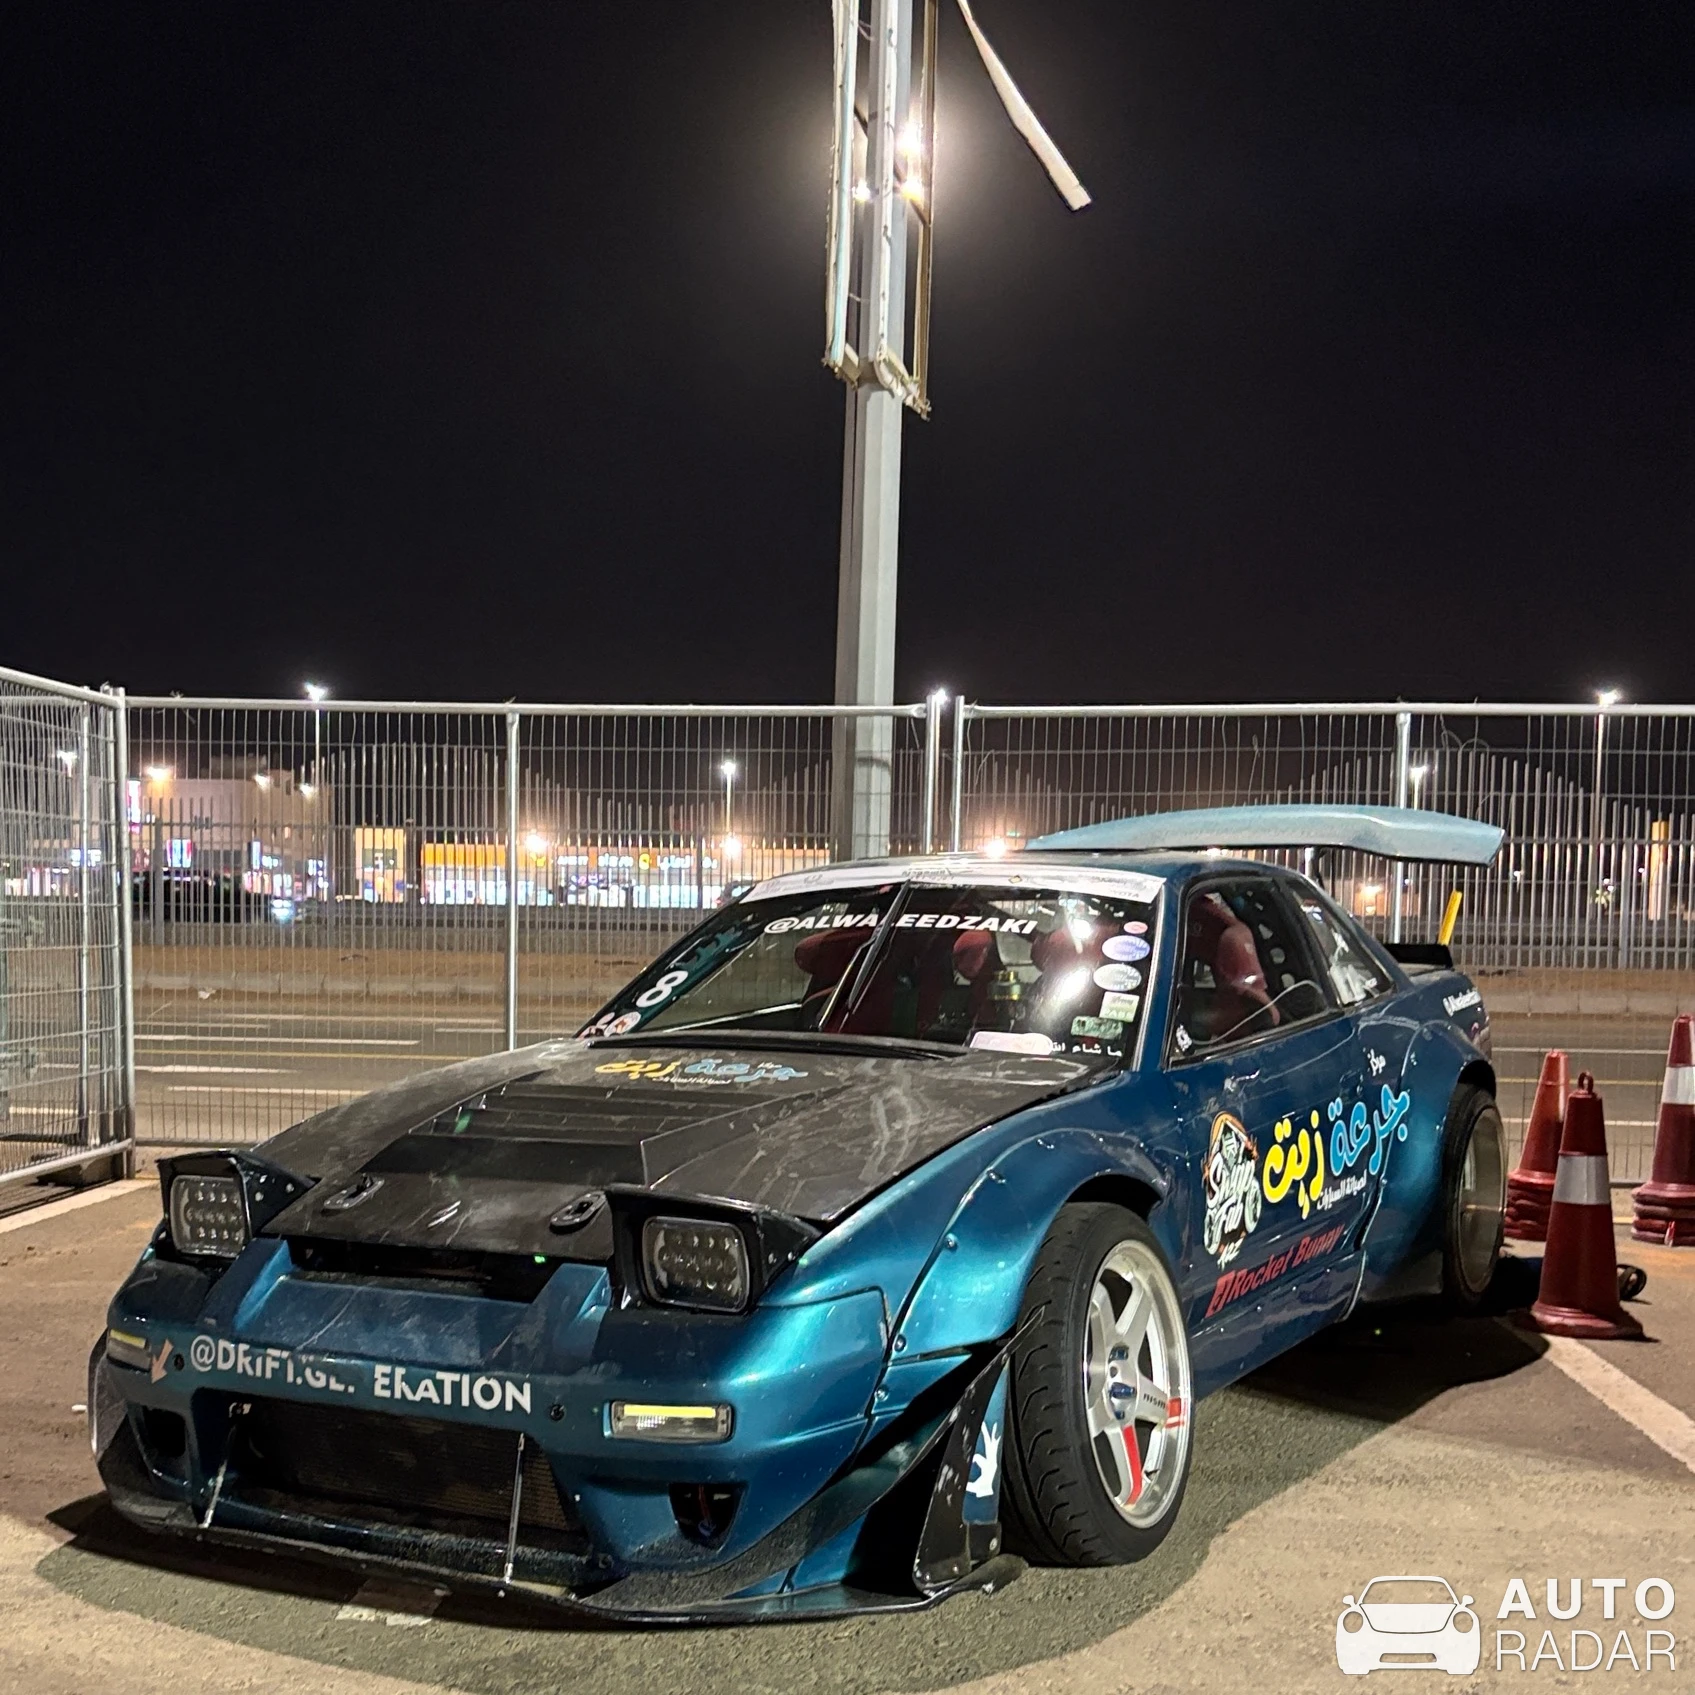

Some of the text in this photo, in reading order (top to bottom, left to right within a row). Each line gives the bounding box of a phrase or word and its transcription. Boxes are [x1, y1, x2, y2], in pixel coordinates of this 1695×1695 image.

[763, 913, 1037, 935] @ALWAEEDZAKI
[635, 970, 689, 1008] 8
[1107, 1046, 1123, 1057] ما
[1263, 1083, 1411, 1219] جرعة زيت
[1226, 1223, 1346, 1304] Rocket Bunny
